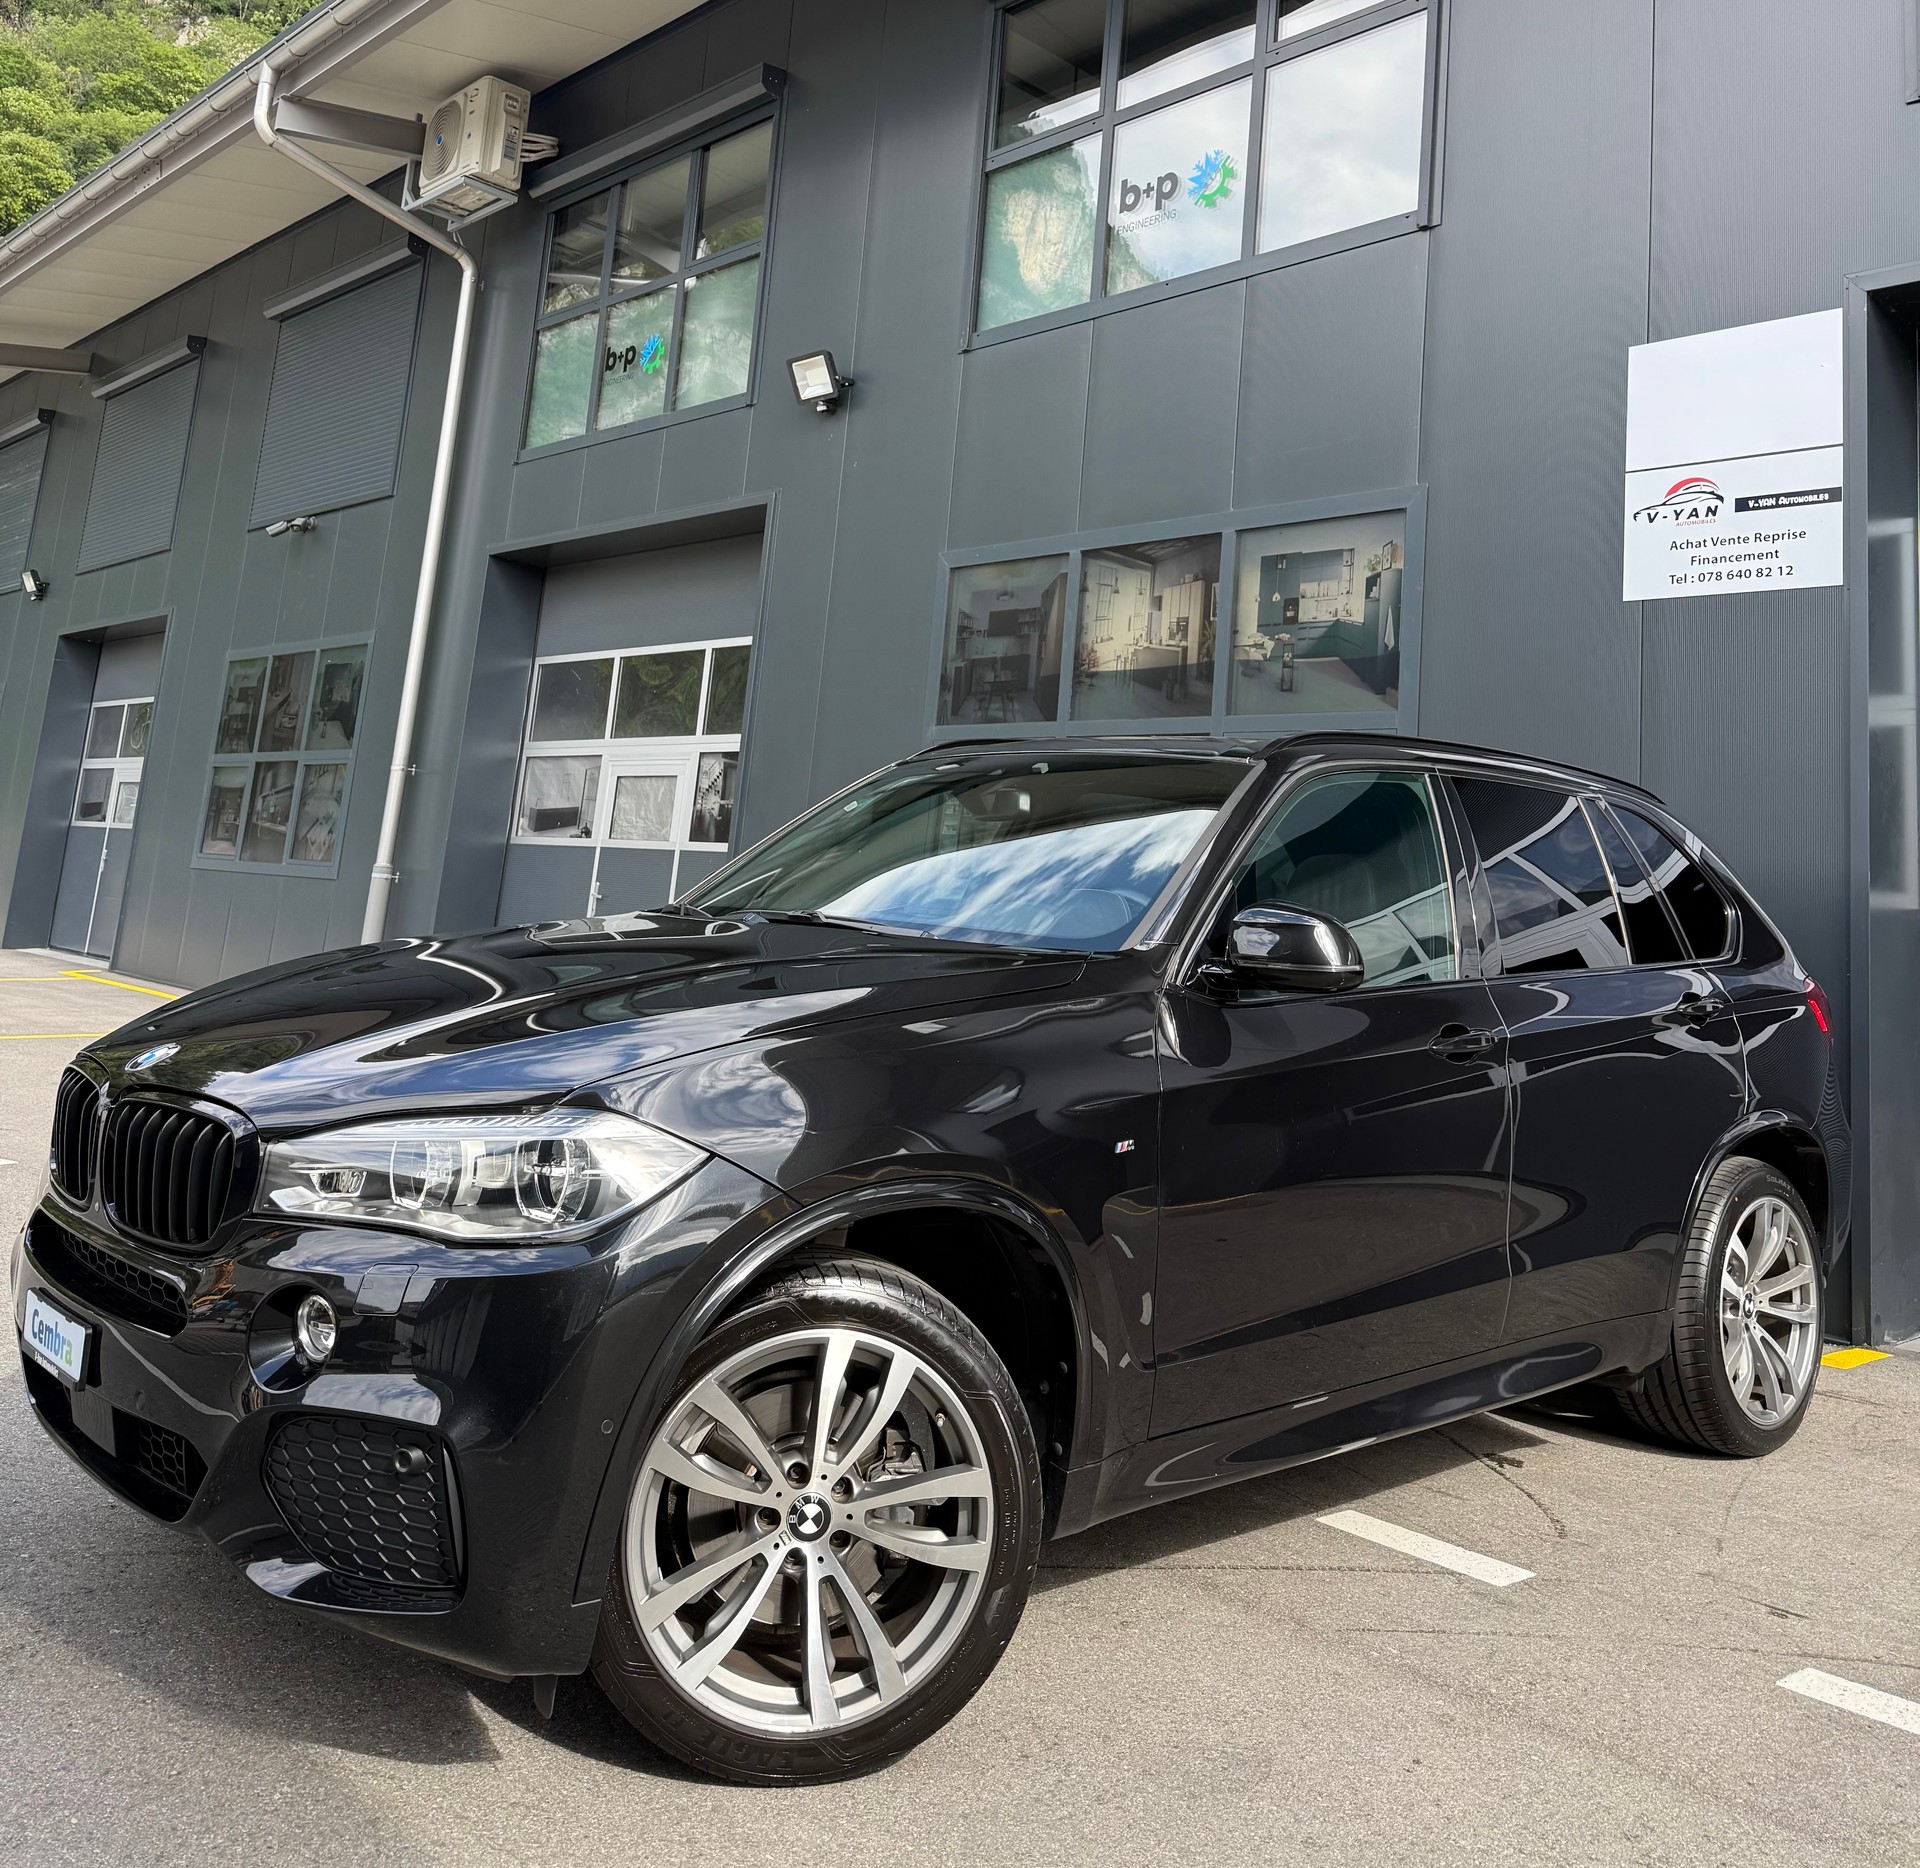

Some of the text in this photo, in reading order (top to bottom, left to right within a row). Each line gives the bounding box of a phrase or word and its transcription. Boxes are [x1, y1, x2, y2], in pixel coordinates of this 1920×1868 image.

[1119, 172, 1179, 214] b+p
[1117, 208, 1177, 236] ENGINEERING
[605, 345, 637, 373] b+p
[1747, 497, 1777, 509] V-YAN
[1675, 518, 1717, 527] AUTOMOBILES
[1669, 528, 1807, 551] Achat Vente Reprise
[1690, 549, 1780, 566] Financement
[1698, 570, 1723, 583] 078
[1726, 568, 1752, 581] 640
[1756, 566, 1773, 578] 82
[1778, 565, 1794, 577] 12
[32, 1308, 73, 1367] Cembra
[788, 1494, 820, 1524] BMW
